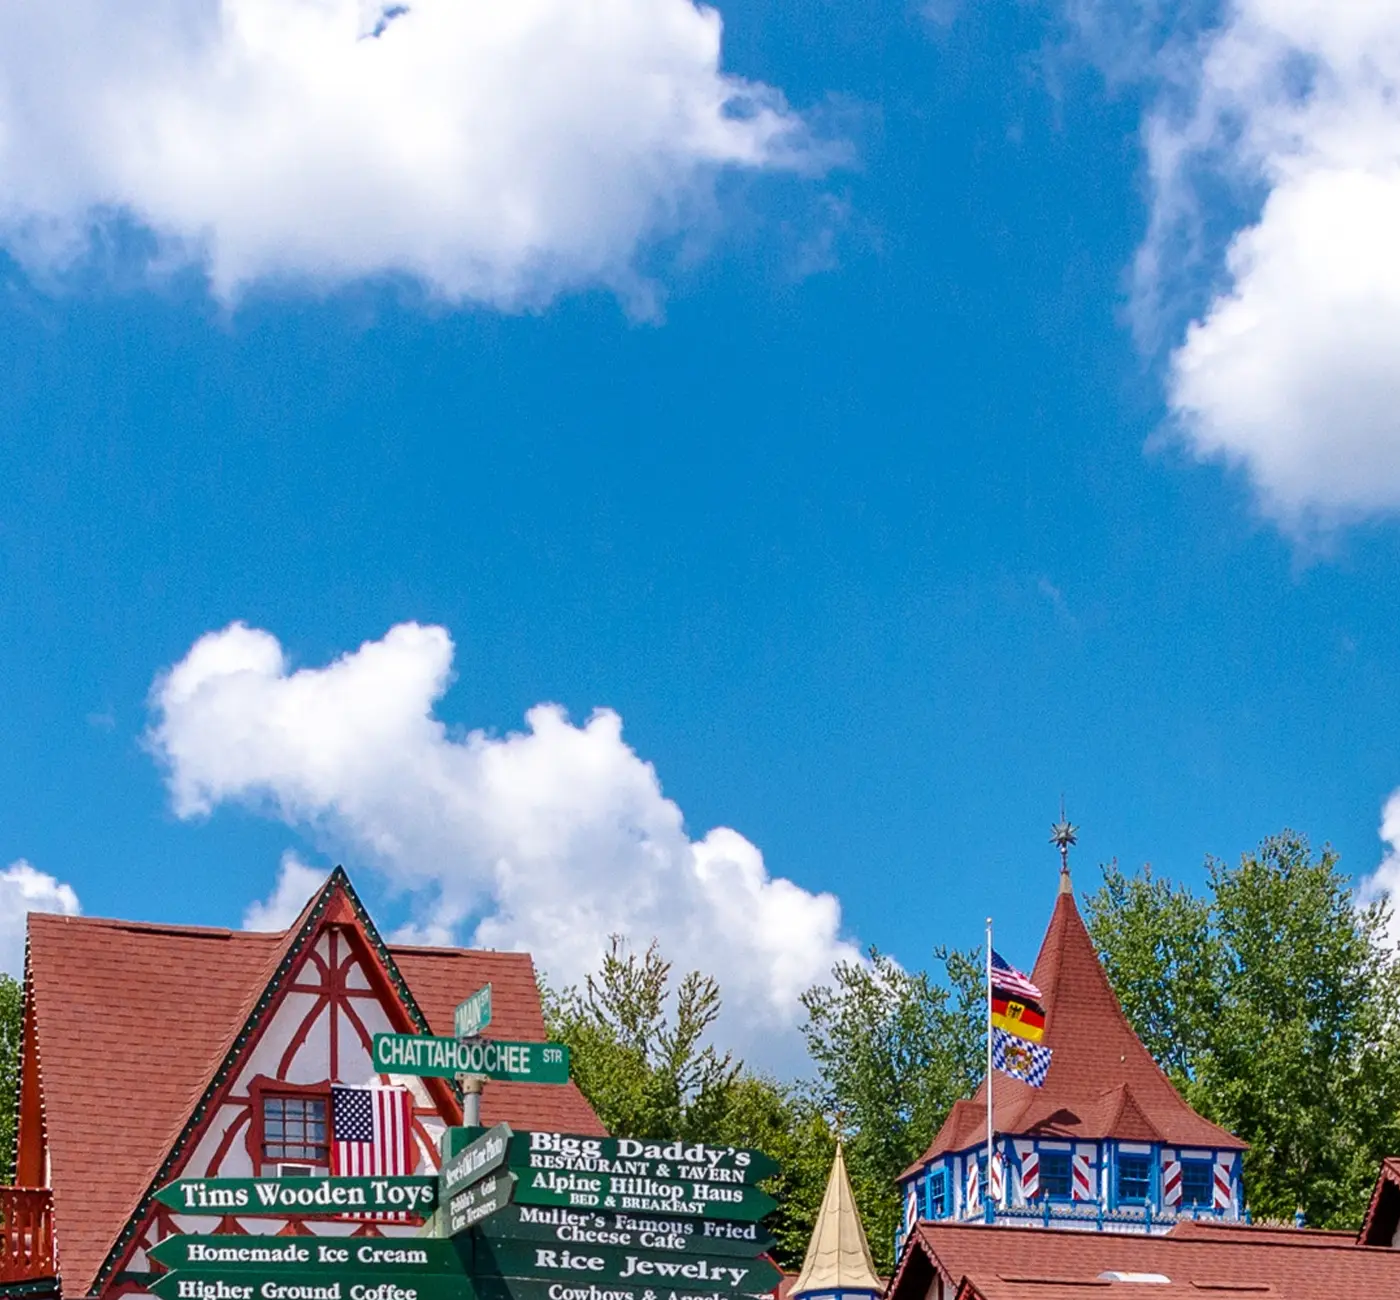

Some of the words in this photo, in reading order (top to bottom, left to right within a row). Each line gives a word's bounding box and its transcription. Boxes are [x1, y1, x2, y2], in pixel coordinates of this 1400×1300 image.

[378, 1037, 530, 1073] CHATTAHOOCHEE
[542, 1048, 562, 1063] STR
[529, 1131, 601, 1160] Bigg
[617, 1138, 751, 1169] Daddy's
[530, 1154, 649, 1176] RESTAURANT
[656, 1164, 670, 1178] &
[678, 1164, 746, 1184] TAVERN
[180, 1182, 249, 1208] Tims
[254, 1180, 365, 1206] Wooden
[371, 1180, 434, 1210] Toys
[531, 1171, 601, 1195] Alpine
[609, 1176, 684, 1201] Hilltop
[692, 1183, 743, 1203] Haus
[569, 1193, 599, 1207] BED
[604, 1196, 616, 1208] &
[622, 1196, 706, 1215] BREAKFAST
[519, 1206, 605, 1229] Muller's
[615, 1213, 694, 1235] Famous
[703, 1221, 757, 1241] Fried
[556, 1224, 631, 1246] Cheese
[640, 1232, 686, 1251] Cafe
[187, 1243, 310, 1263] Homemade
[317, 1245, 349, 1263] Ice
[357, 1246, 428, 1264] Cream
[535, 1248, 605, 1271] Rice
[619, 1255, 749, 1287] Jewelry
